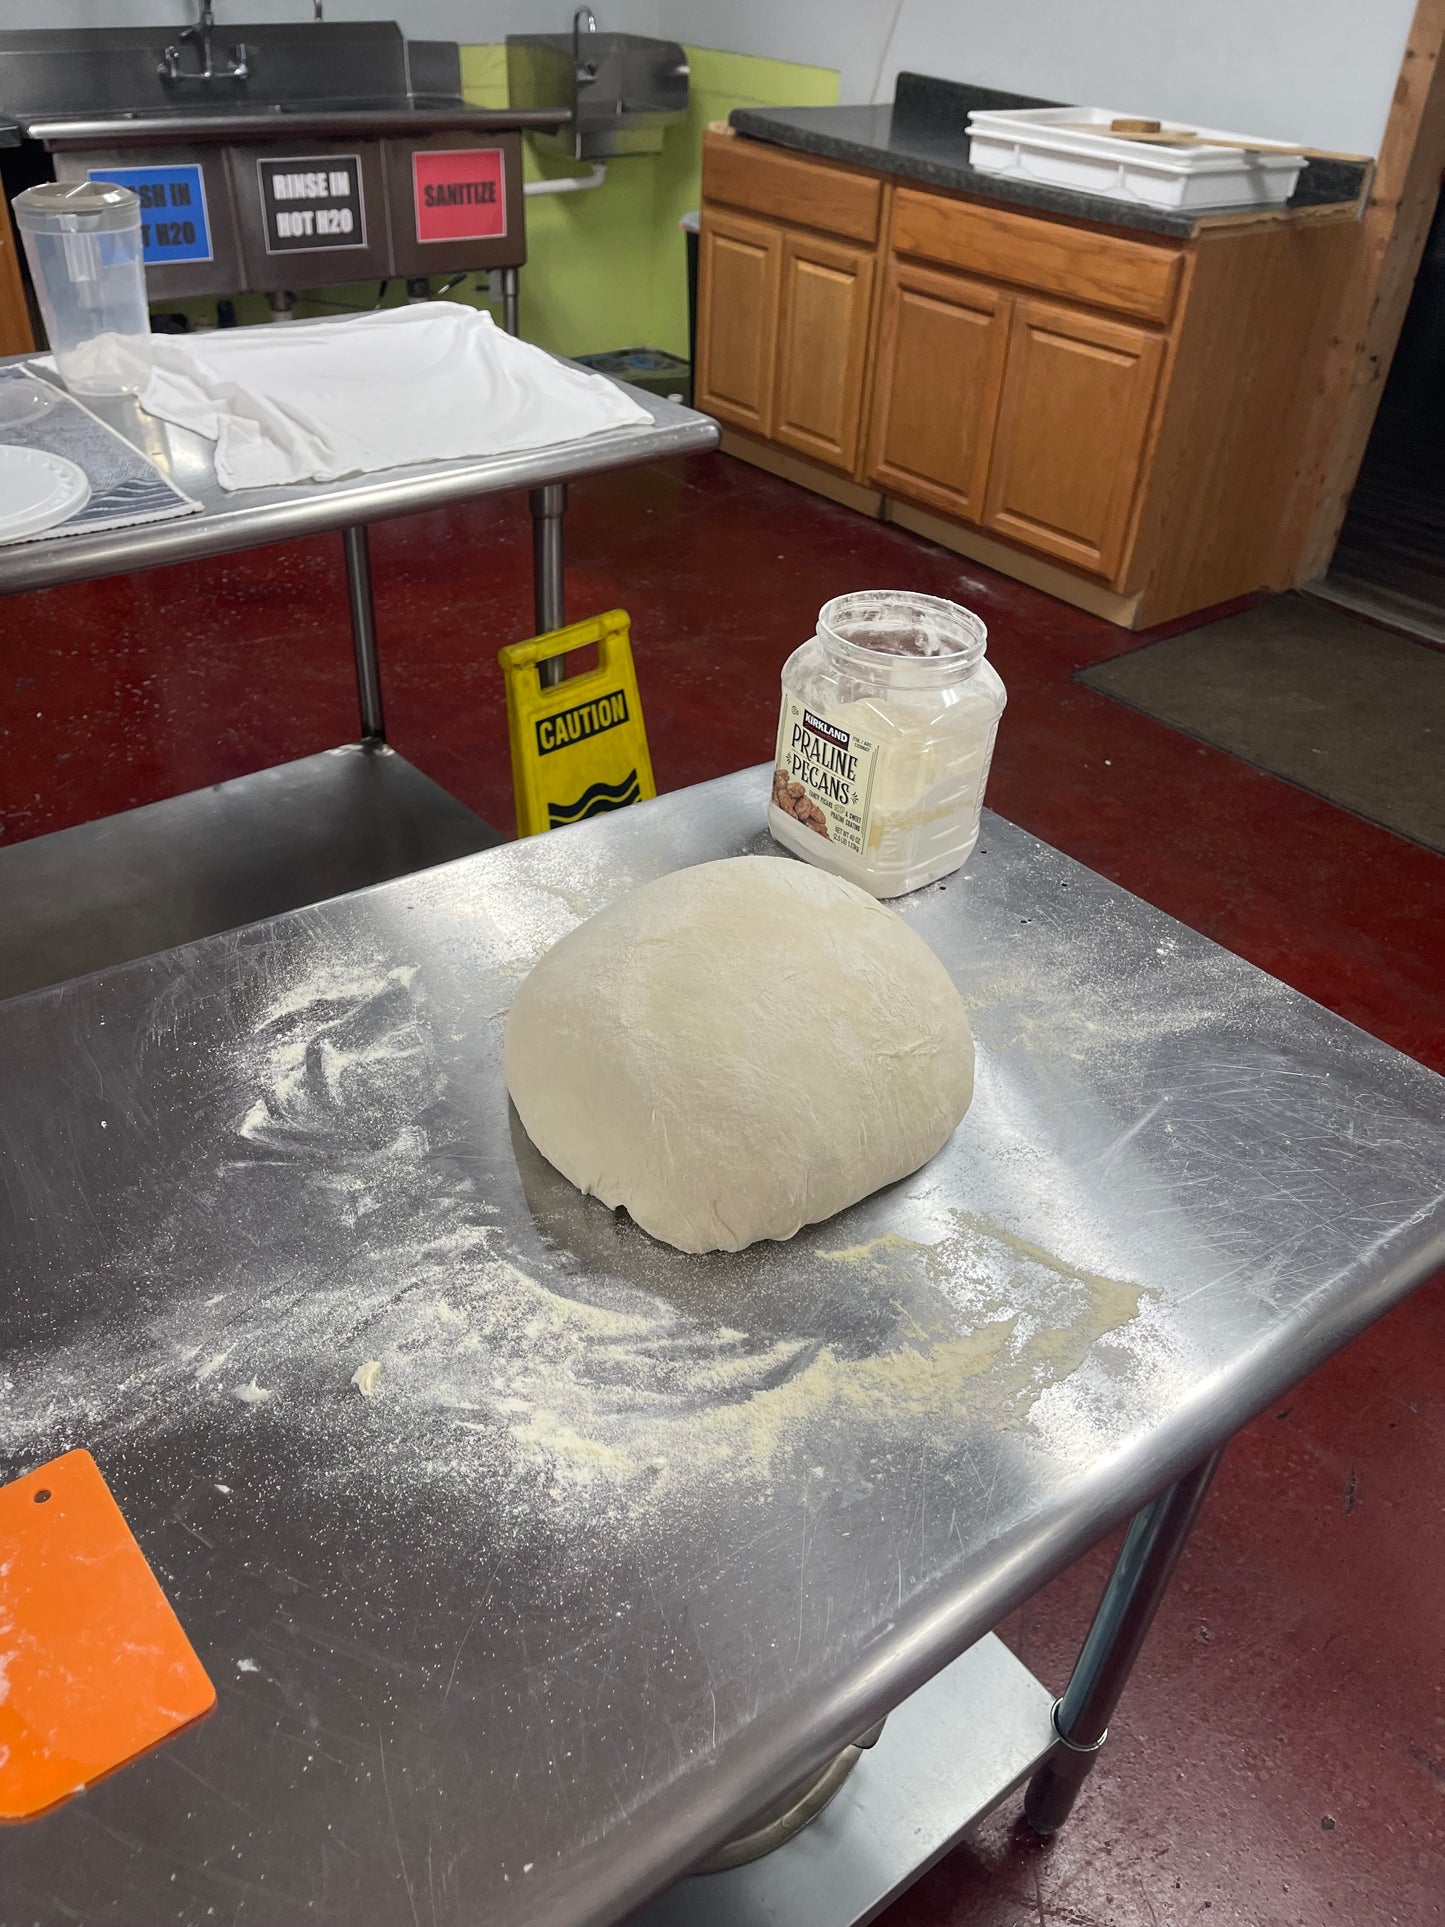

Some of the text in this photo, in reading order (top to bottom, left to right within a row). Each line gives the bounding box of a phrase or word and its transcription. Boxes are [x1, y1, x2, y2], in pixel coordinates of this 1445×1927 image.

[169, 182, 191, 206] IN
[272, 171, 350, 200] RINSE IN
[423, 181, 496, 207] SANITIZE
[276, 211, 314, 238] HOT
[539, 693, 626, 750] CAUTION
[805, 712, 848, 743] KIRKLAND
[791, 723, 858, 782] PRALINE
[792, 753, 850, 805] PECANS
